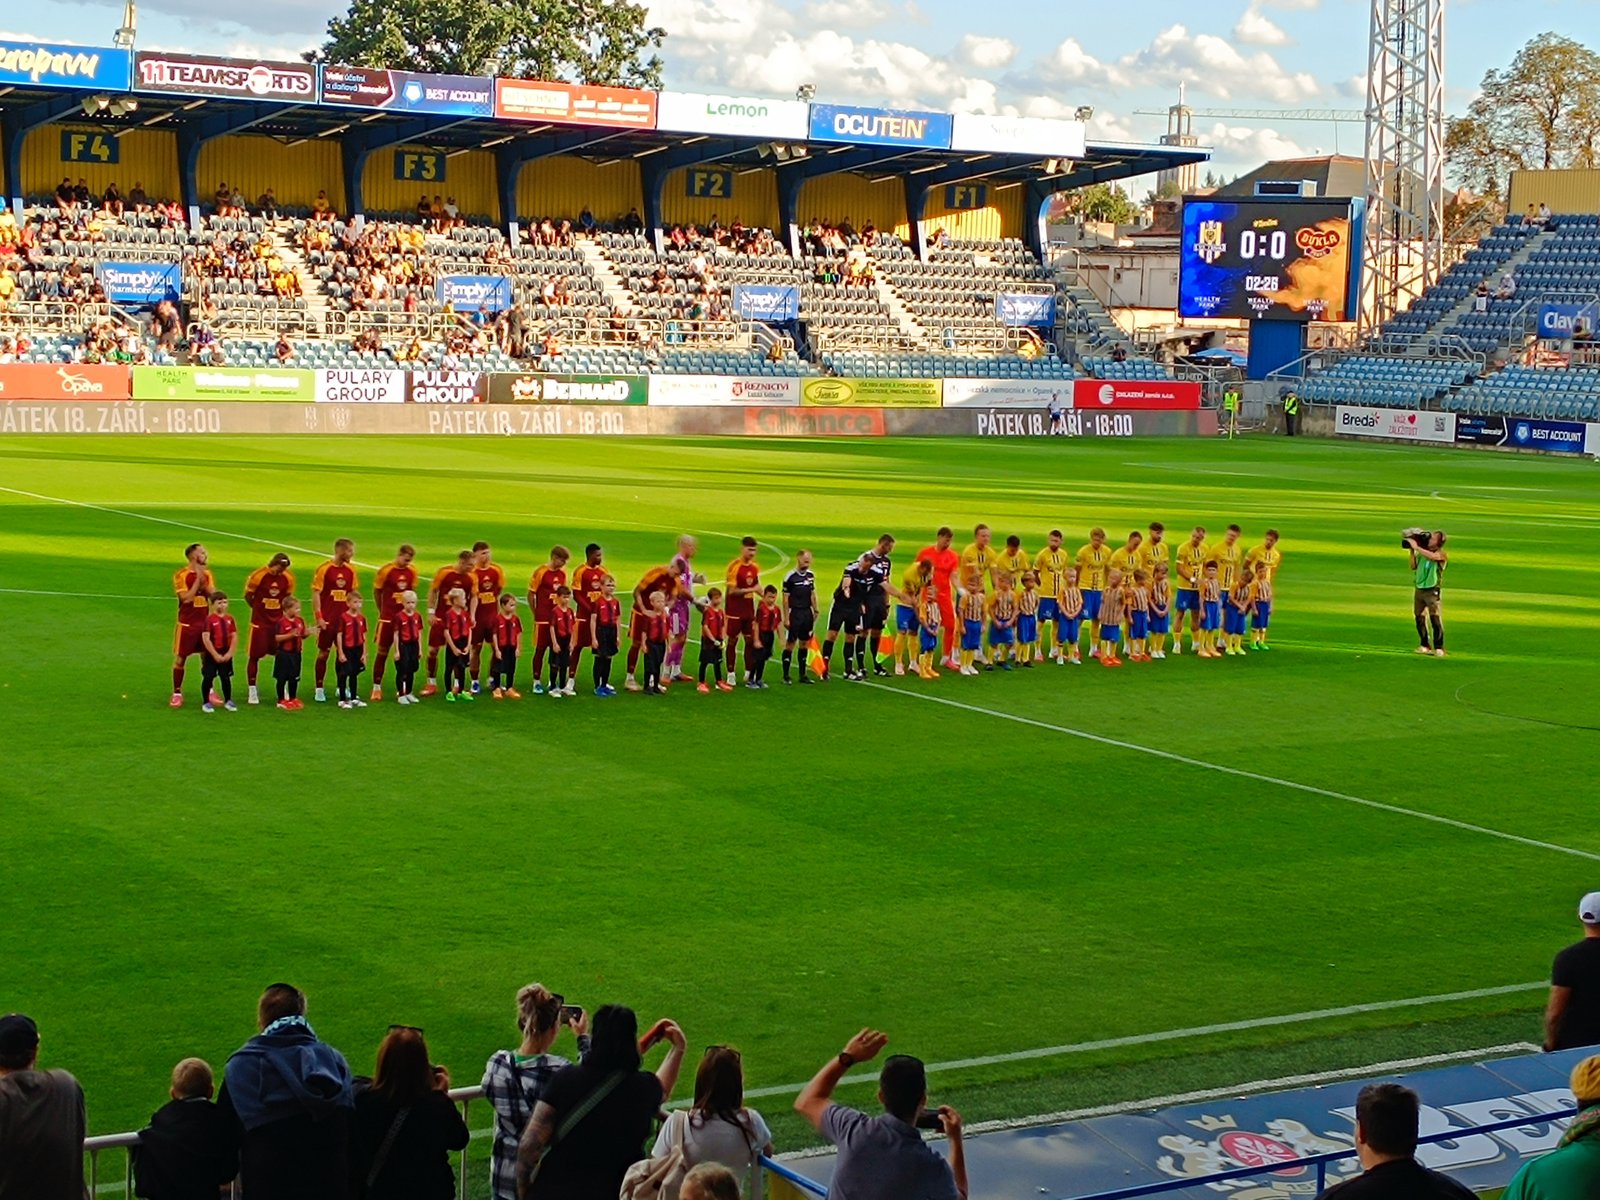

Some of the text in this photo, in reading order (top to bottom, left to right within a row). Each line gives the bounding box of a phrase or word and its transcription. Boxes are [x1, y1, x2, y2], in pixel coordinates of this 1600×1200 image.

[425, 88, 449, 101] BEST
[449, 90, 489, 103] ACCOUNT
[706, 102, 768, 118] Lemon
[834, 113, 924, 139] OCUTEIN
[1300, 232, 1338, 247] DUKLA
[1544, 312, 1591, 328] Clavn
[326, 370, 393, 384] PULARY
[413, 371, 481, 387] PULARY
[61, 379, 103, 396] Opava
[744, 381, 789, 390] ŘEZNICTVÍ
[326, 387, 387, 401] GROUP
[0, 401, 220, 433] ÁTEK 18. ZÁŘÍ 18:00
[428, 405, 487, 434] PÁTEK
[520, 405, 561, 434] ZÁŘÍ
[579, 411, 624, 434] 18:00
[759, 408, 873, 434] Chance
[977, 408, 1025, 436] PÁTEK
[1028, 413, 1047, 436] 18.
[1096, 414, 1133, 436] 18:00
[1342, 413, 1375, 427] Breda
[1532, 428, 1583, 442] BEST ACCOUNT
